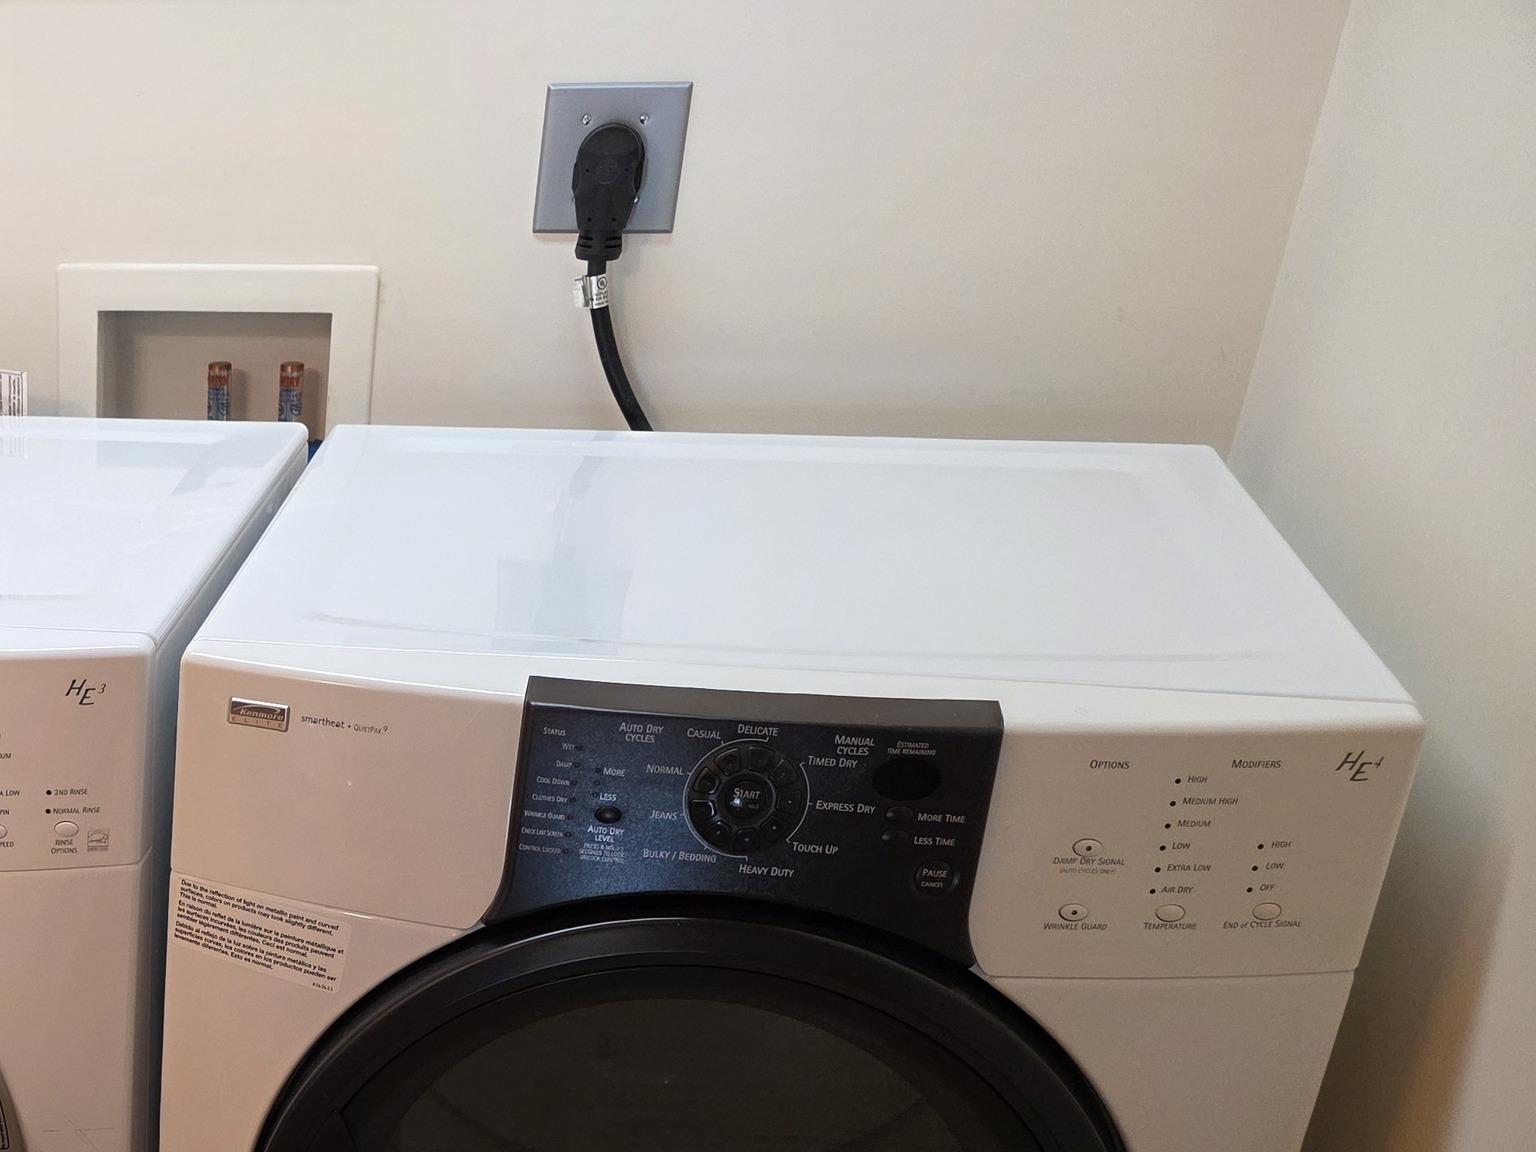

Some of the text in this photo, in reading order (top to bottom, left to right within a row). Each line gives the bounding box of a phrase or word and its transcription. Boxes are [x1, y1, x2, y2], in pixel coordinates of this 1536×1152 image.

[239, 708, 284, 721] Kenmore
[231, 717, 283, 728] ELITE
[301, 714, 345, 729] smartheat
[543, 727, 566, 736] STATUS
[619, 722, 664, 734] AUTO DRY
[738, 724, 779, 736] DELICATE
[625, 734, 655, 743] CYCLES
[687, 728, 721, 740] CASUAL
[834, 734, 875, 747] MANUAL
[837, 746, 869, 756] CYCLES
[807, 755, 858, 768] TIMED DRY
[1089, 760, 1130, 770] OPTIONS
[1232, 759, 1282, 769] MODIFIERS
[603, 767, 625, 777] MORE
[646, 764, 684, 776] NORMAL
[600, 792, 617, 801] LESS
[733, 788, 760, 799] START
[816, 800, 876, 814] EXPRESS DRY
[649, 810, 678, 820] JEANS
[918, 813, 966, 823] MORE TIME
[1177, 820, 1211, 828] MEDIUM
[587, 825, 625, 835] AUTO DRY
[595, 835, 614, 843] LEVEL
[914, 836, 956, 846] LESS TIME
[792, 841, 838, 855] TOUCH UP
[1172, 842, 1190, 850] LOW
[643, 849, 717, 863] BULKY BEDDING
[1053, 857, 1125, 866] DAMP DRY SIGNAL
[739, 864, 794, 877] HEAVY DUTY
[922, 868, 948, 878] PAUSE
[1166, 864, 1191, 872] EXTRA
[1043, 922, 1107, 931] WRINKLE GUARD
[1144, 922, 1197, 930] TEMPERATURE
[1223, 921, 1239, 929] END
